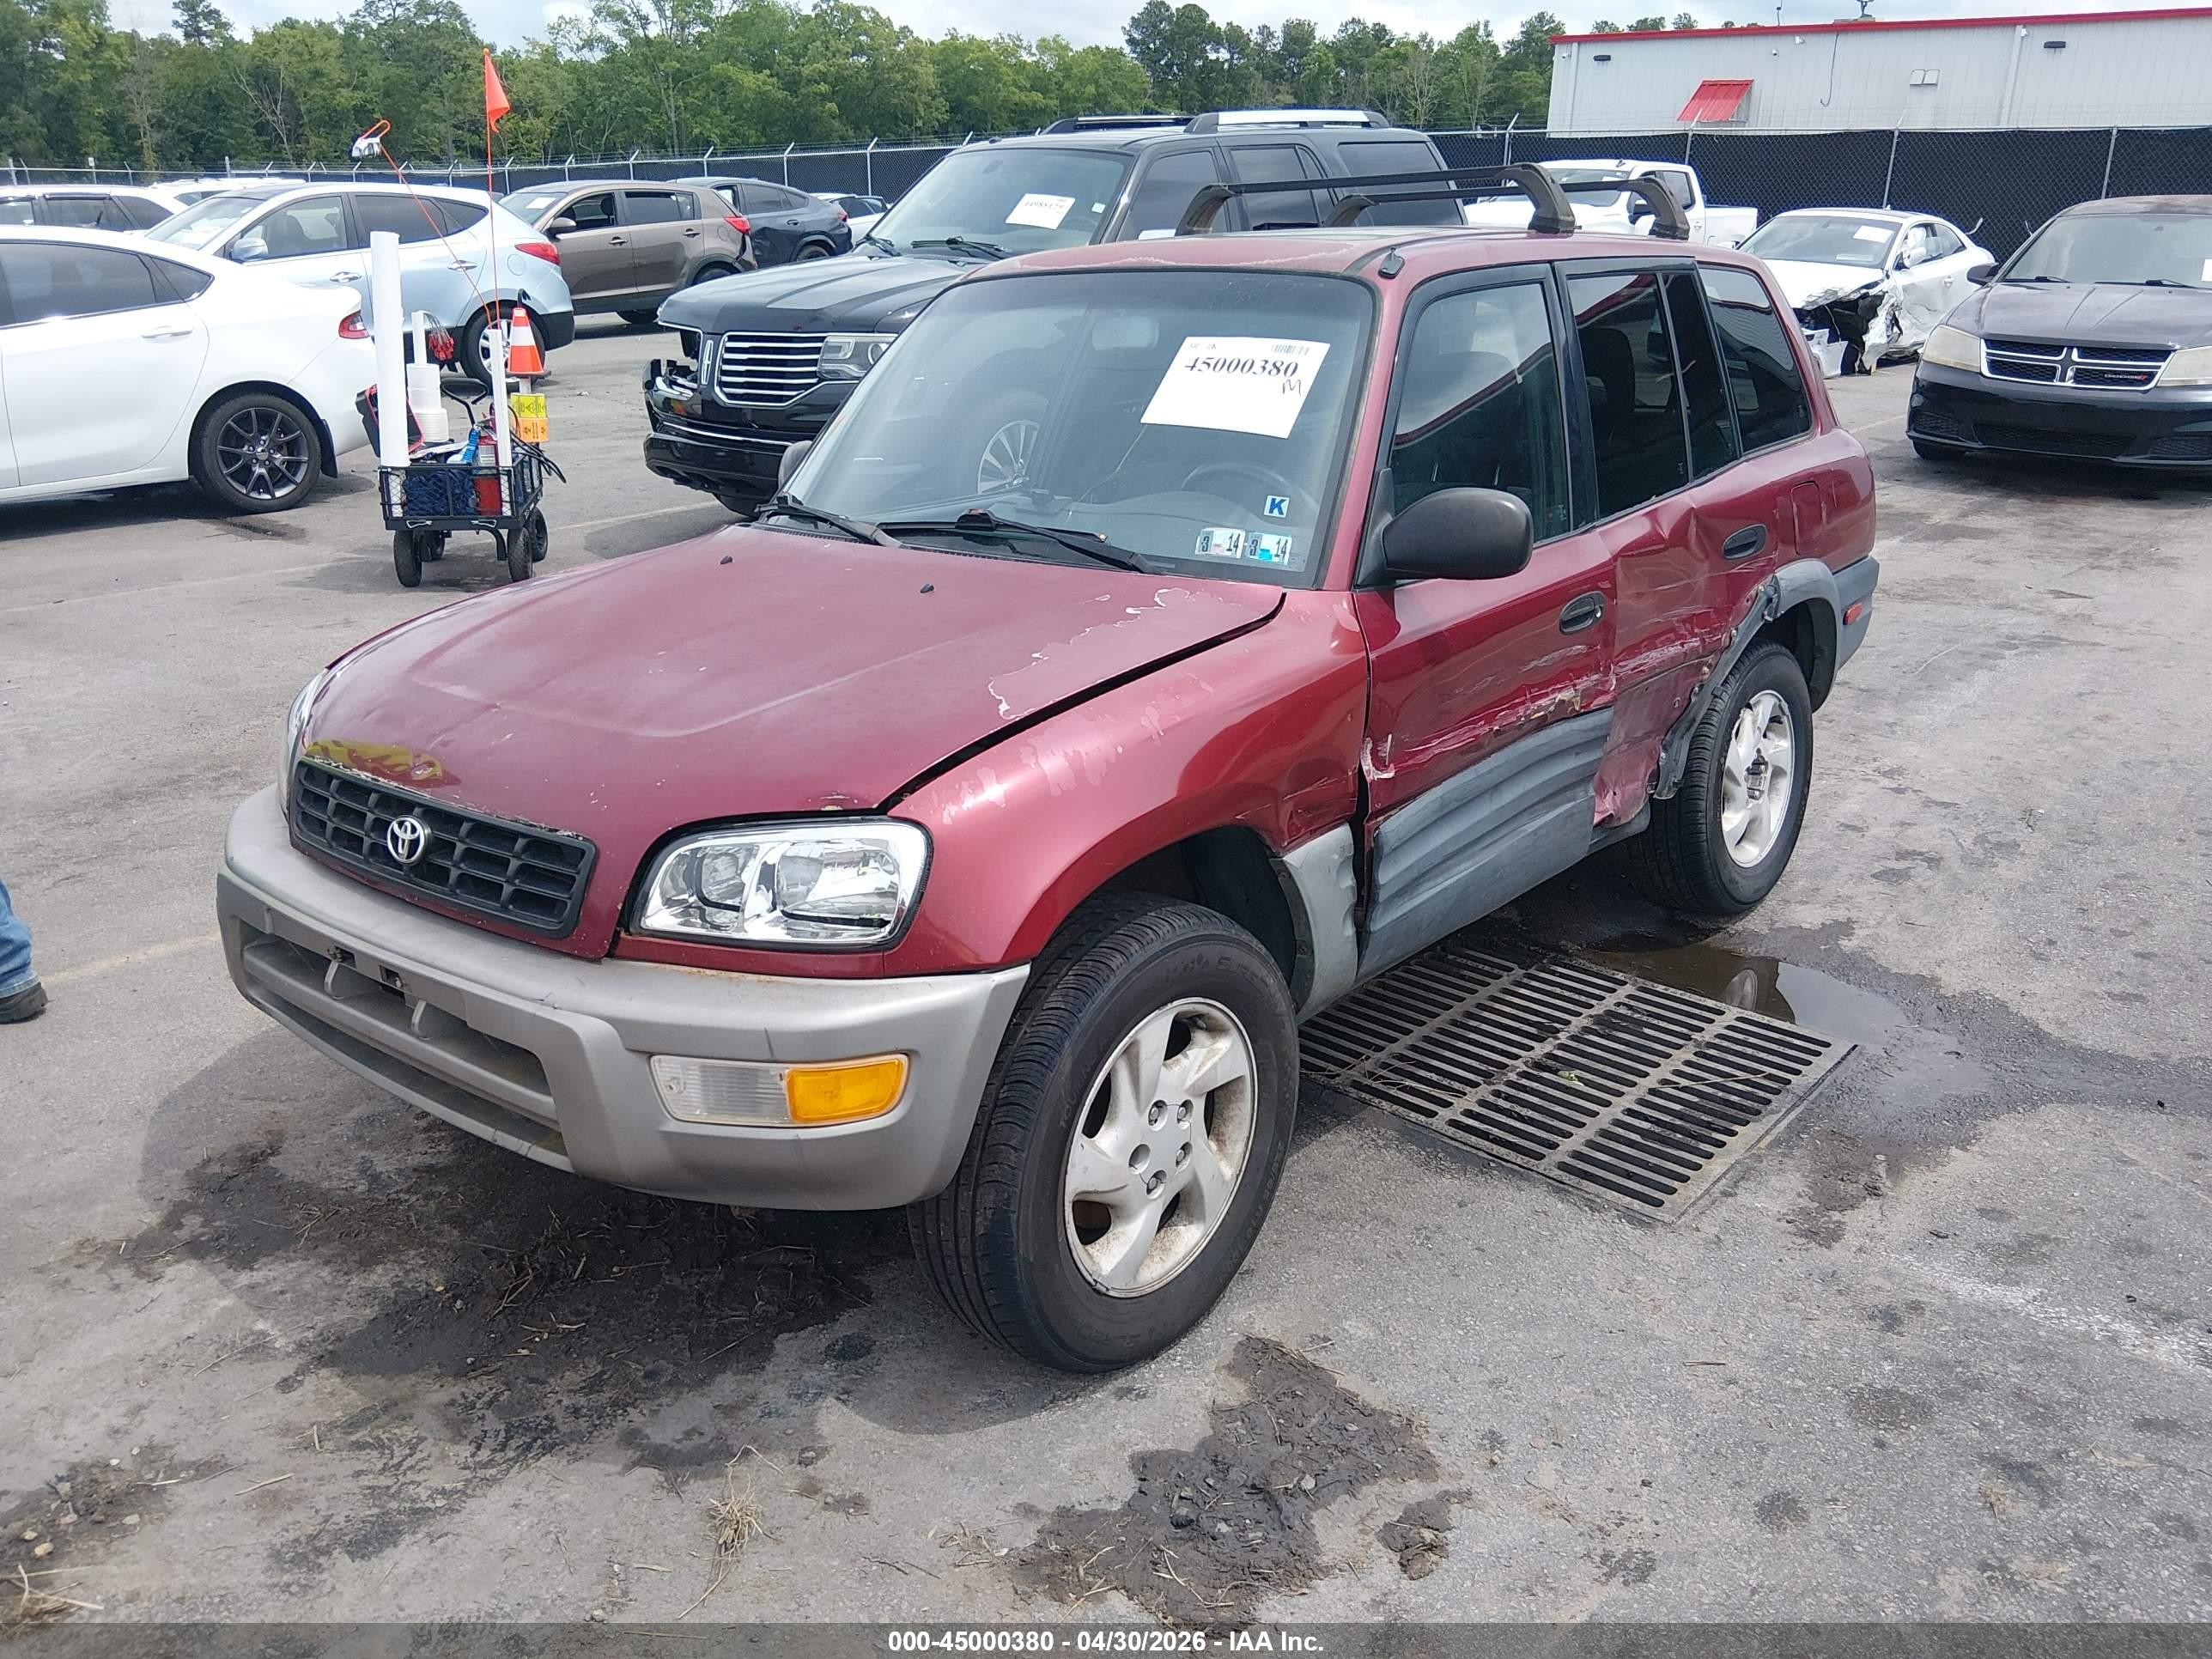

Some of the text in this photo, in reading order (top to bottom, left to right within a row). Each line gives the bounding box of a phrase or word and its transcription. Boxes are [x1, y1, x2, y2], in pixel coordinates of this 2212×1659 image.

[1184, 356, 1299, 378] 45000380
[1268, 497, 1287, 515] K
[1200, 532, 1241, 553] 3 14
[1249, 537, 1288, 558] 3 14
